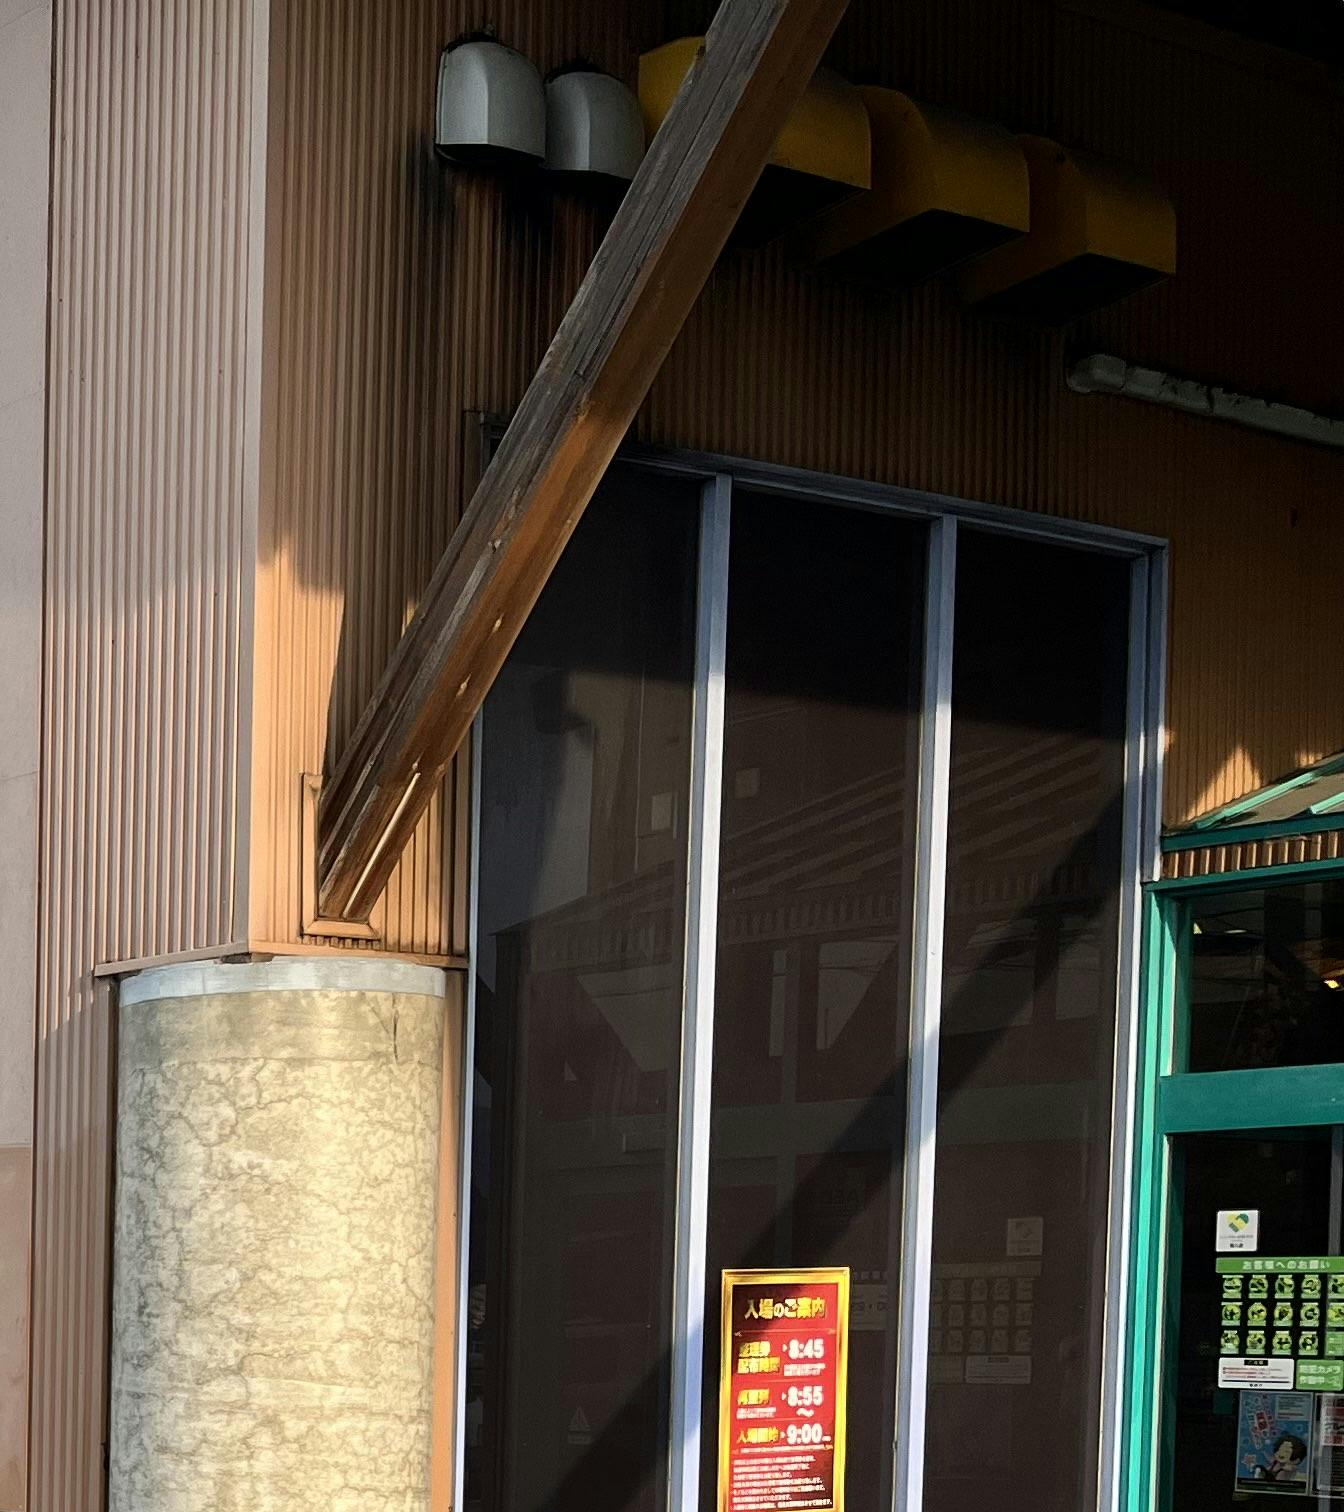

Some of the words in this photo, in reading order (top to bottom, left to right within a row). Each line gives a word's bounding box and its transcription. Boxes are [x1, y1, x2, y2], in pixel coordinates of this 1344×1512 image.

[744, 1297, 826, 1320] 入場のご案内
[789, 1338, 824, 1359] 8:45
[787, 1385, 824, 1407] 8:55
